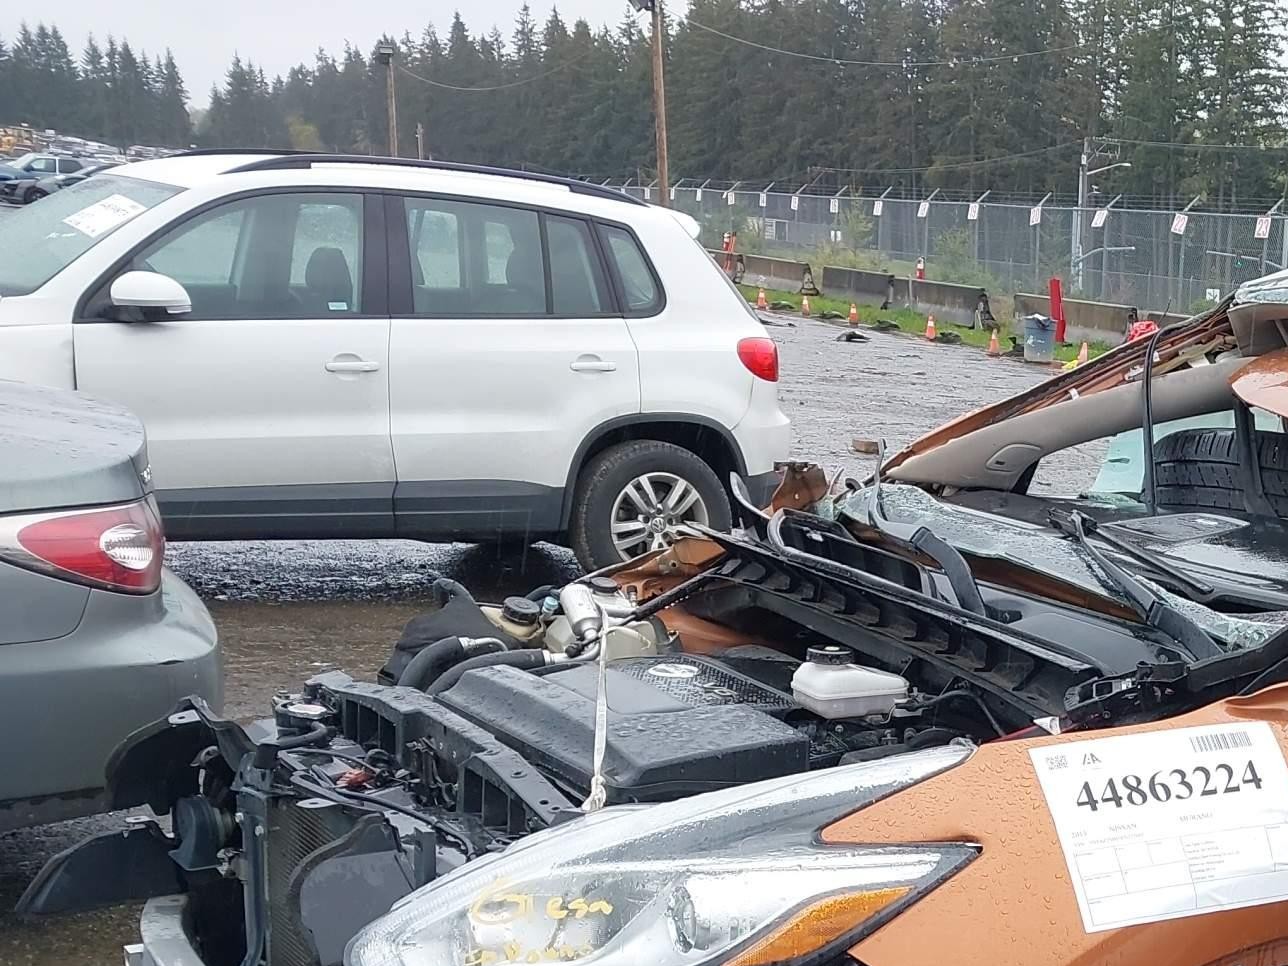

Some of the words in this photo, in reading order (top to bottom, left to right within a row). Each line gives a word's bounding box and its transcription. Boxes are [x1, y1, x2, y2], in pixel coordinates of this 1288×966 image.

[1030, 208, 1041, 224] 20
[1173, 215, 1186, 232] 22
[1256, 218, 1269, 237] 23
[1076, 759, 1263, 812] 44863224
